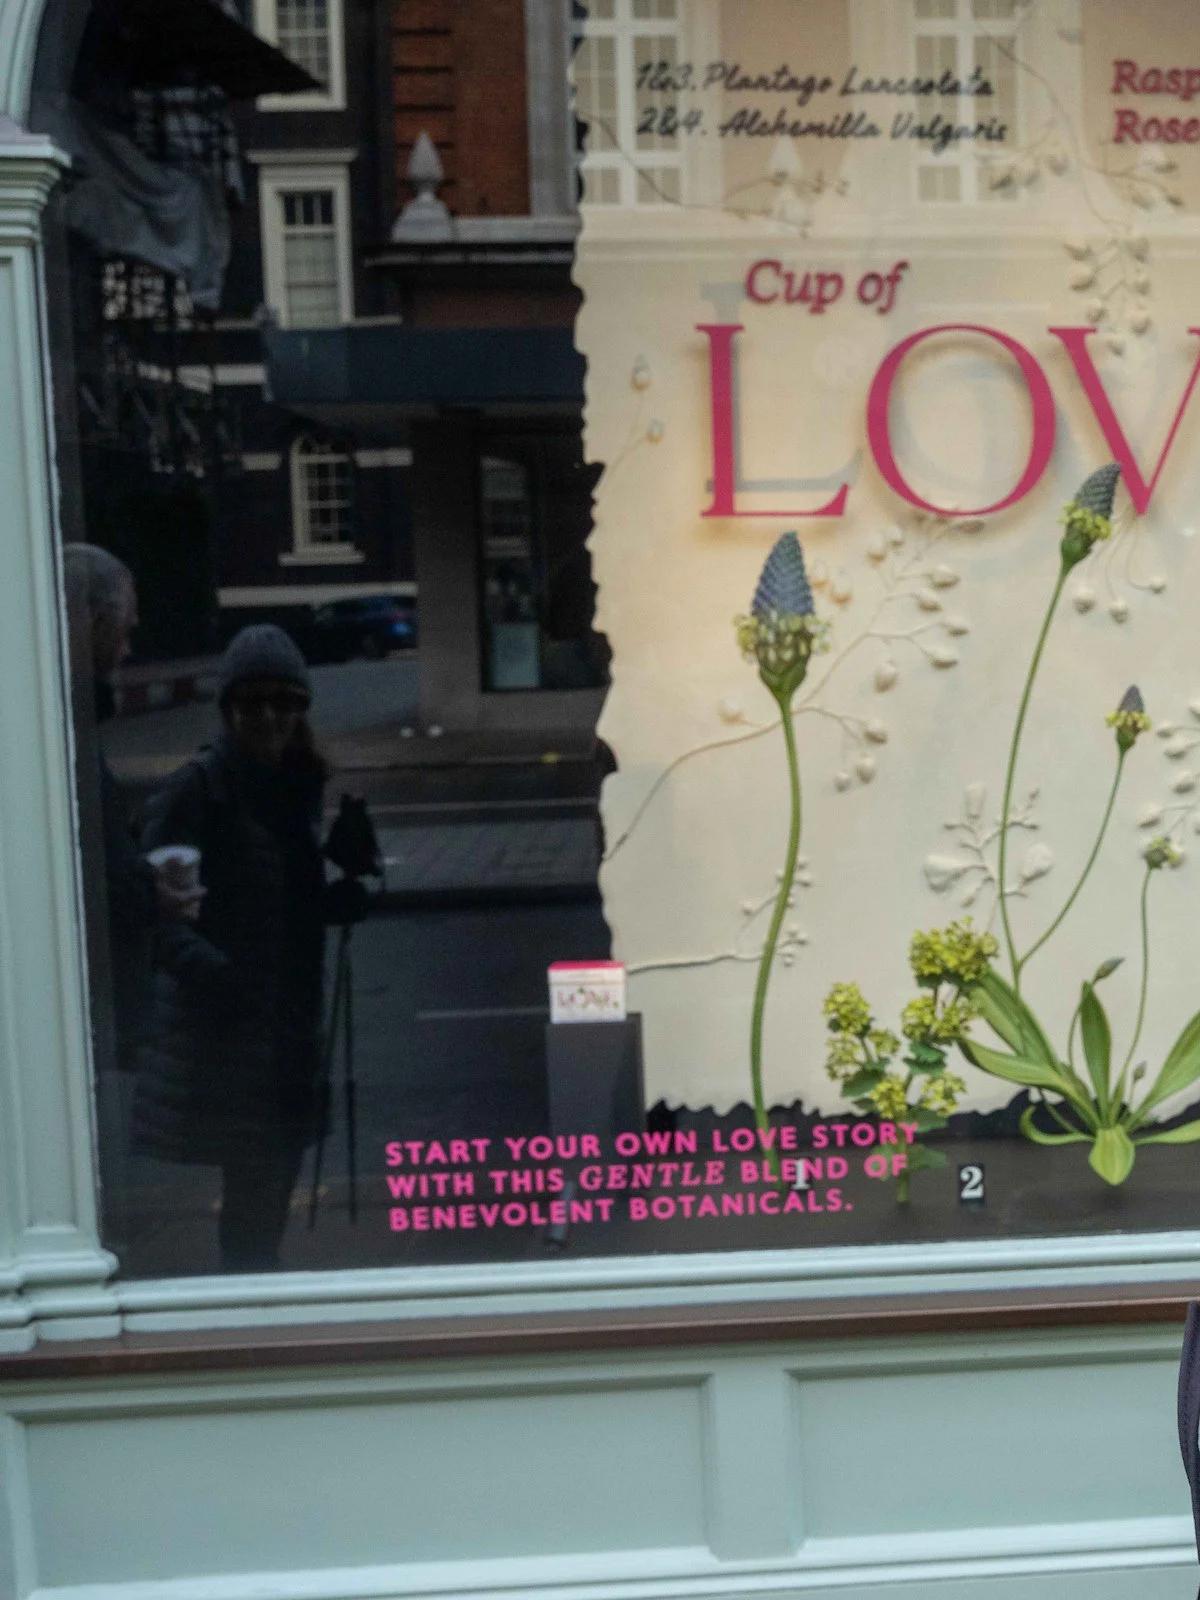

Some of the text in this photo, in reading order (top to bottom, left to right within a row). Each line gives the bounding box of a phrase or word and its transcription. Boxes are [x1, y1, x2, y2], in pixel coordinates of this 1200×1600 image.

[702, 61, 833, 107] Plantago
[719, 107, 881, 137] Alchemilla
[744, 258, 909, 316] Cup of
[385, 1121, 918, 1166] START YOUR OWN LOVE STORY
[386, 1154, 908, 1198] WITH THIS GENTLE BLEND OF
[960, 1166, 984, 1199] 2
[389, 1188, 853, 1231] BENEVOLENT BOTANICALS.
